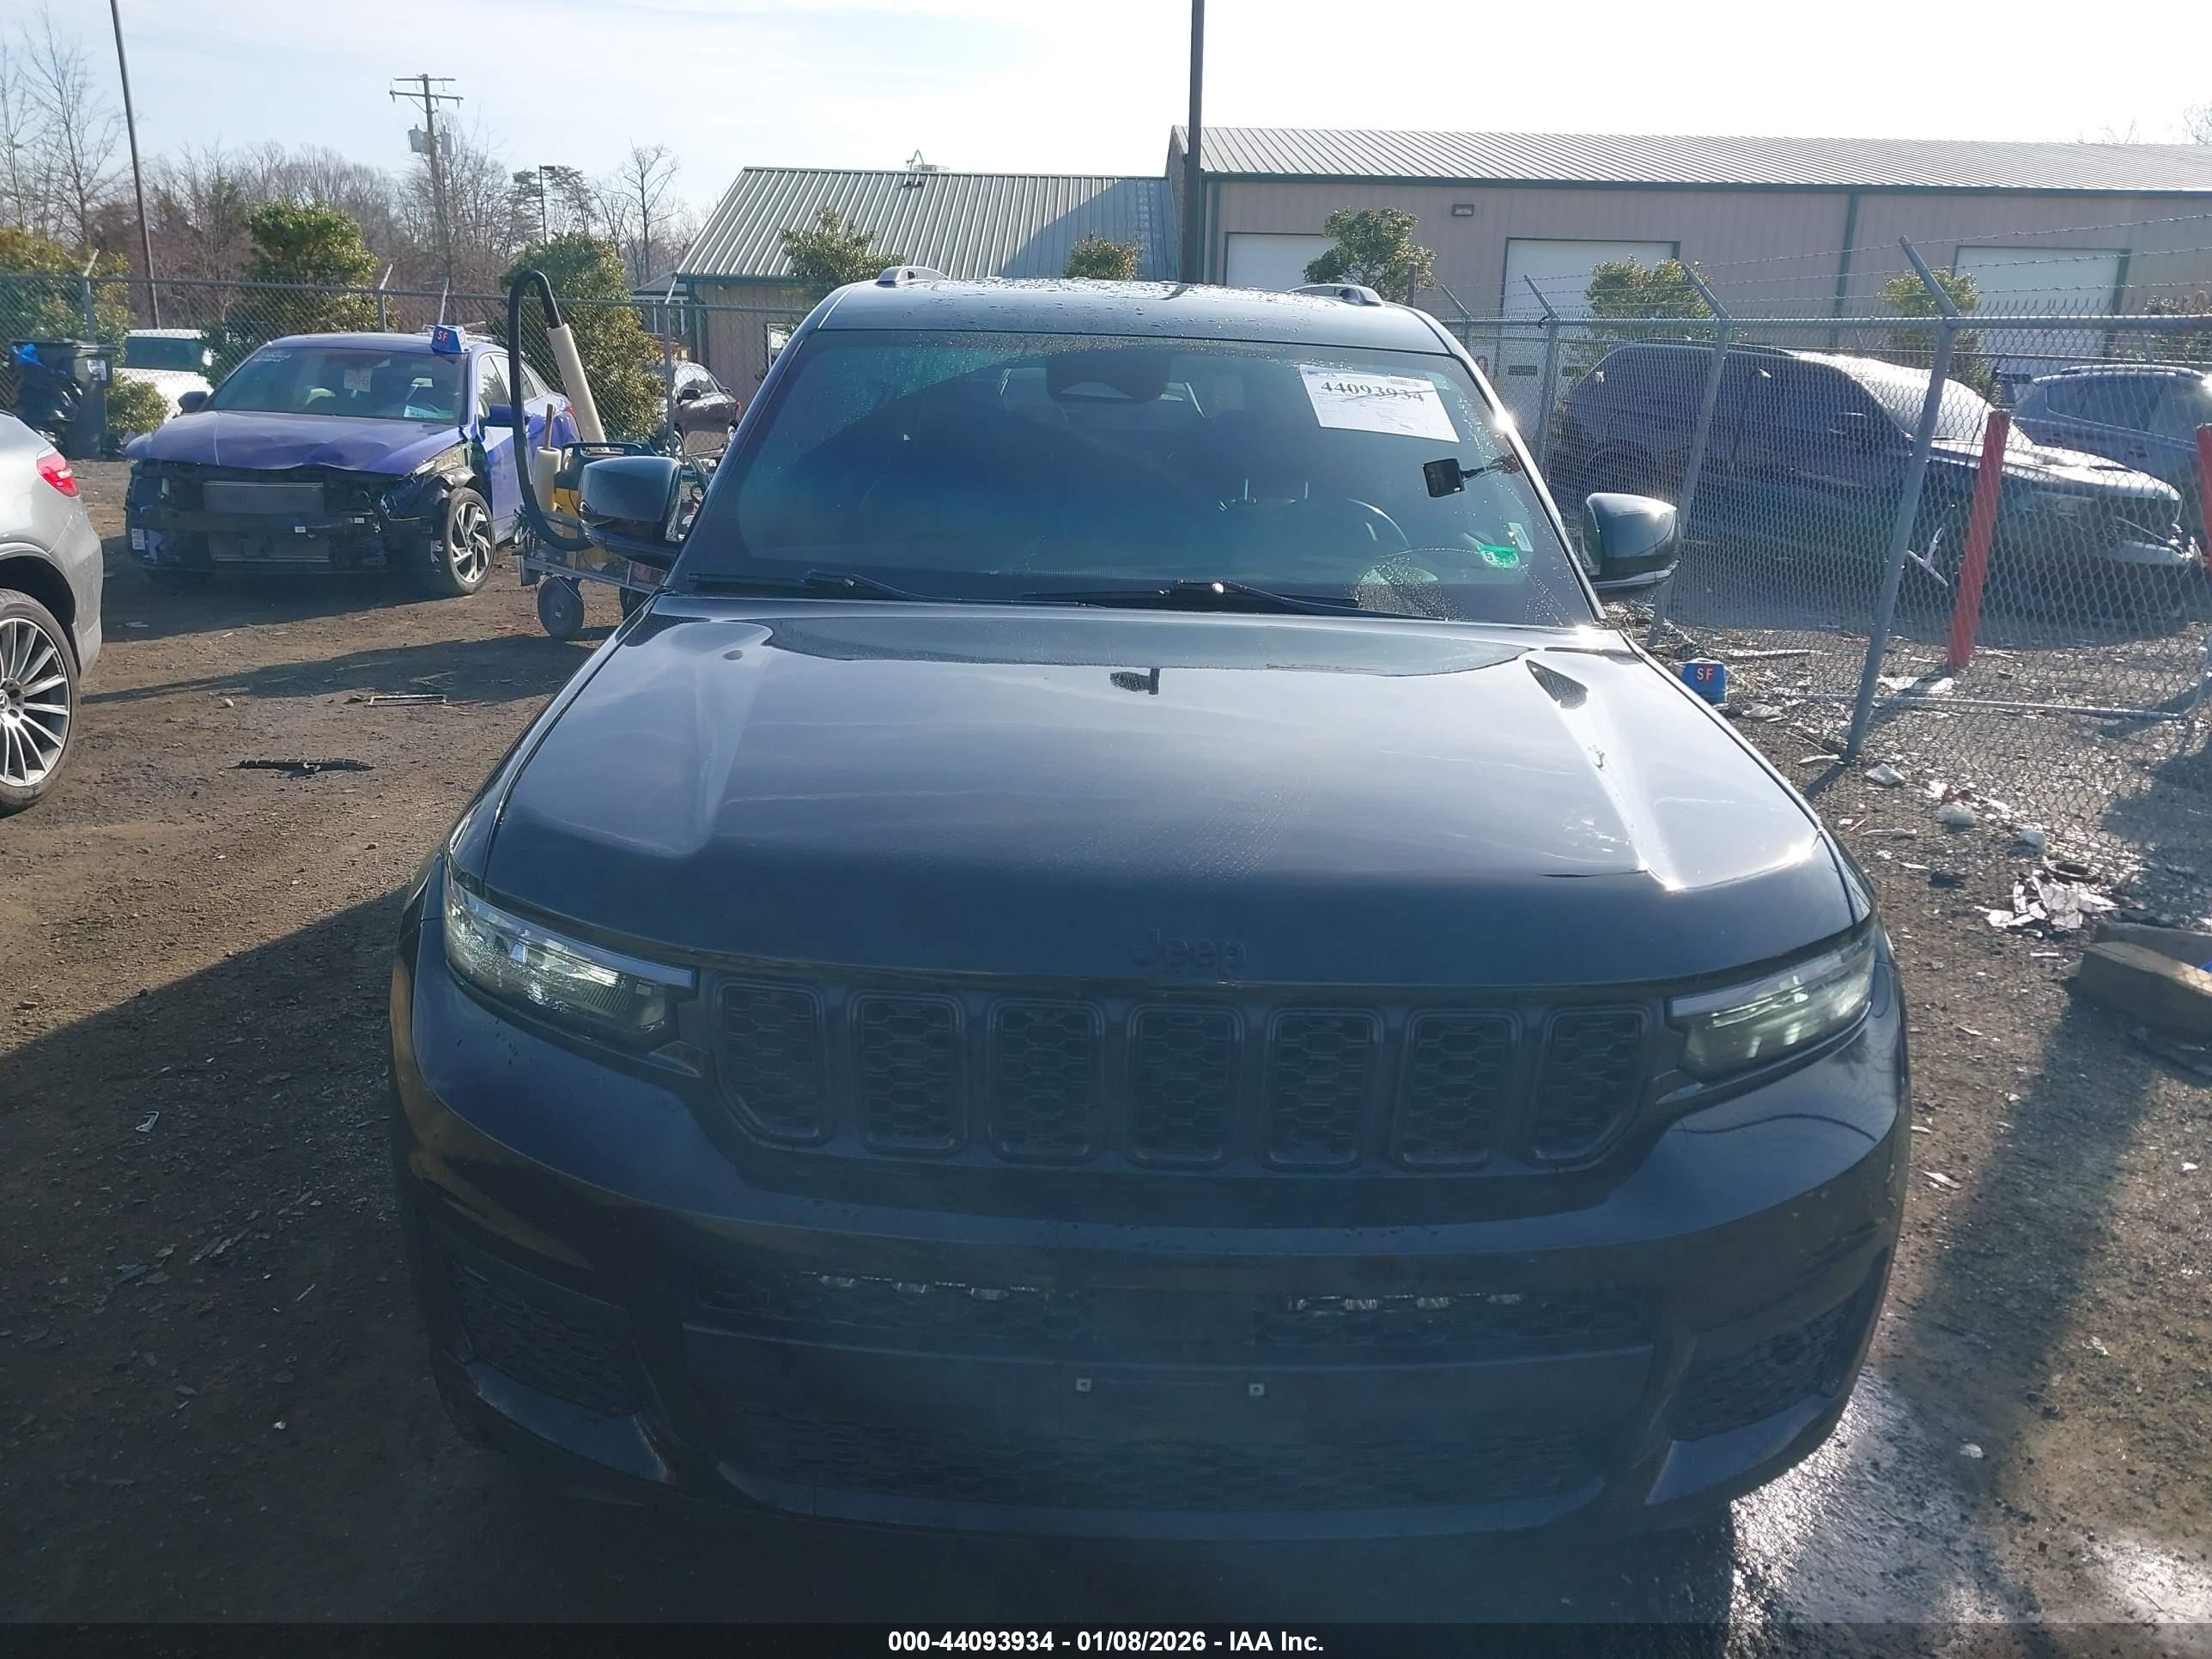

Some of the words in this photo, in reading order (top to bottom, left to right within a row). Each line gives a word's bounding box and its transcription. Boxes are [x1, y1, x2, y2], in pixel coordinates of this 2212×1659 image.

[436, 330, 448, 342] SF
[1321, 381, 1425, 402] 44093934
[1696, 667, 1714, 681] SF
[1130, 926, 1249, 981] Jeep
